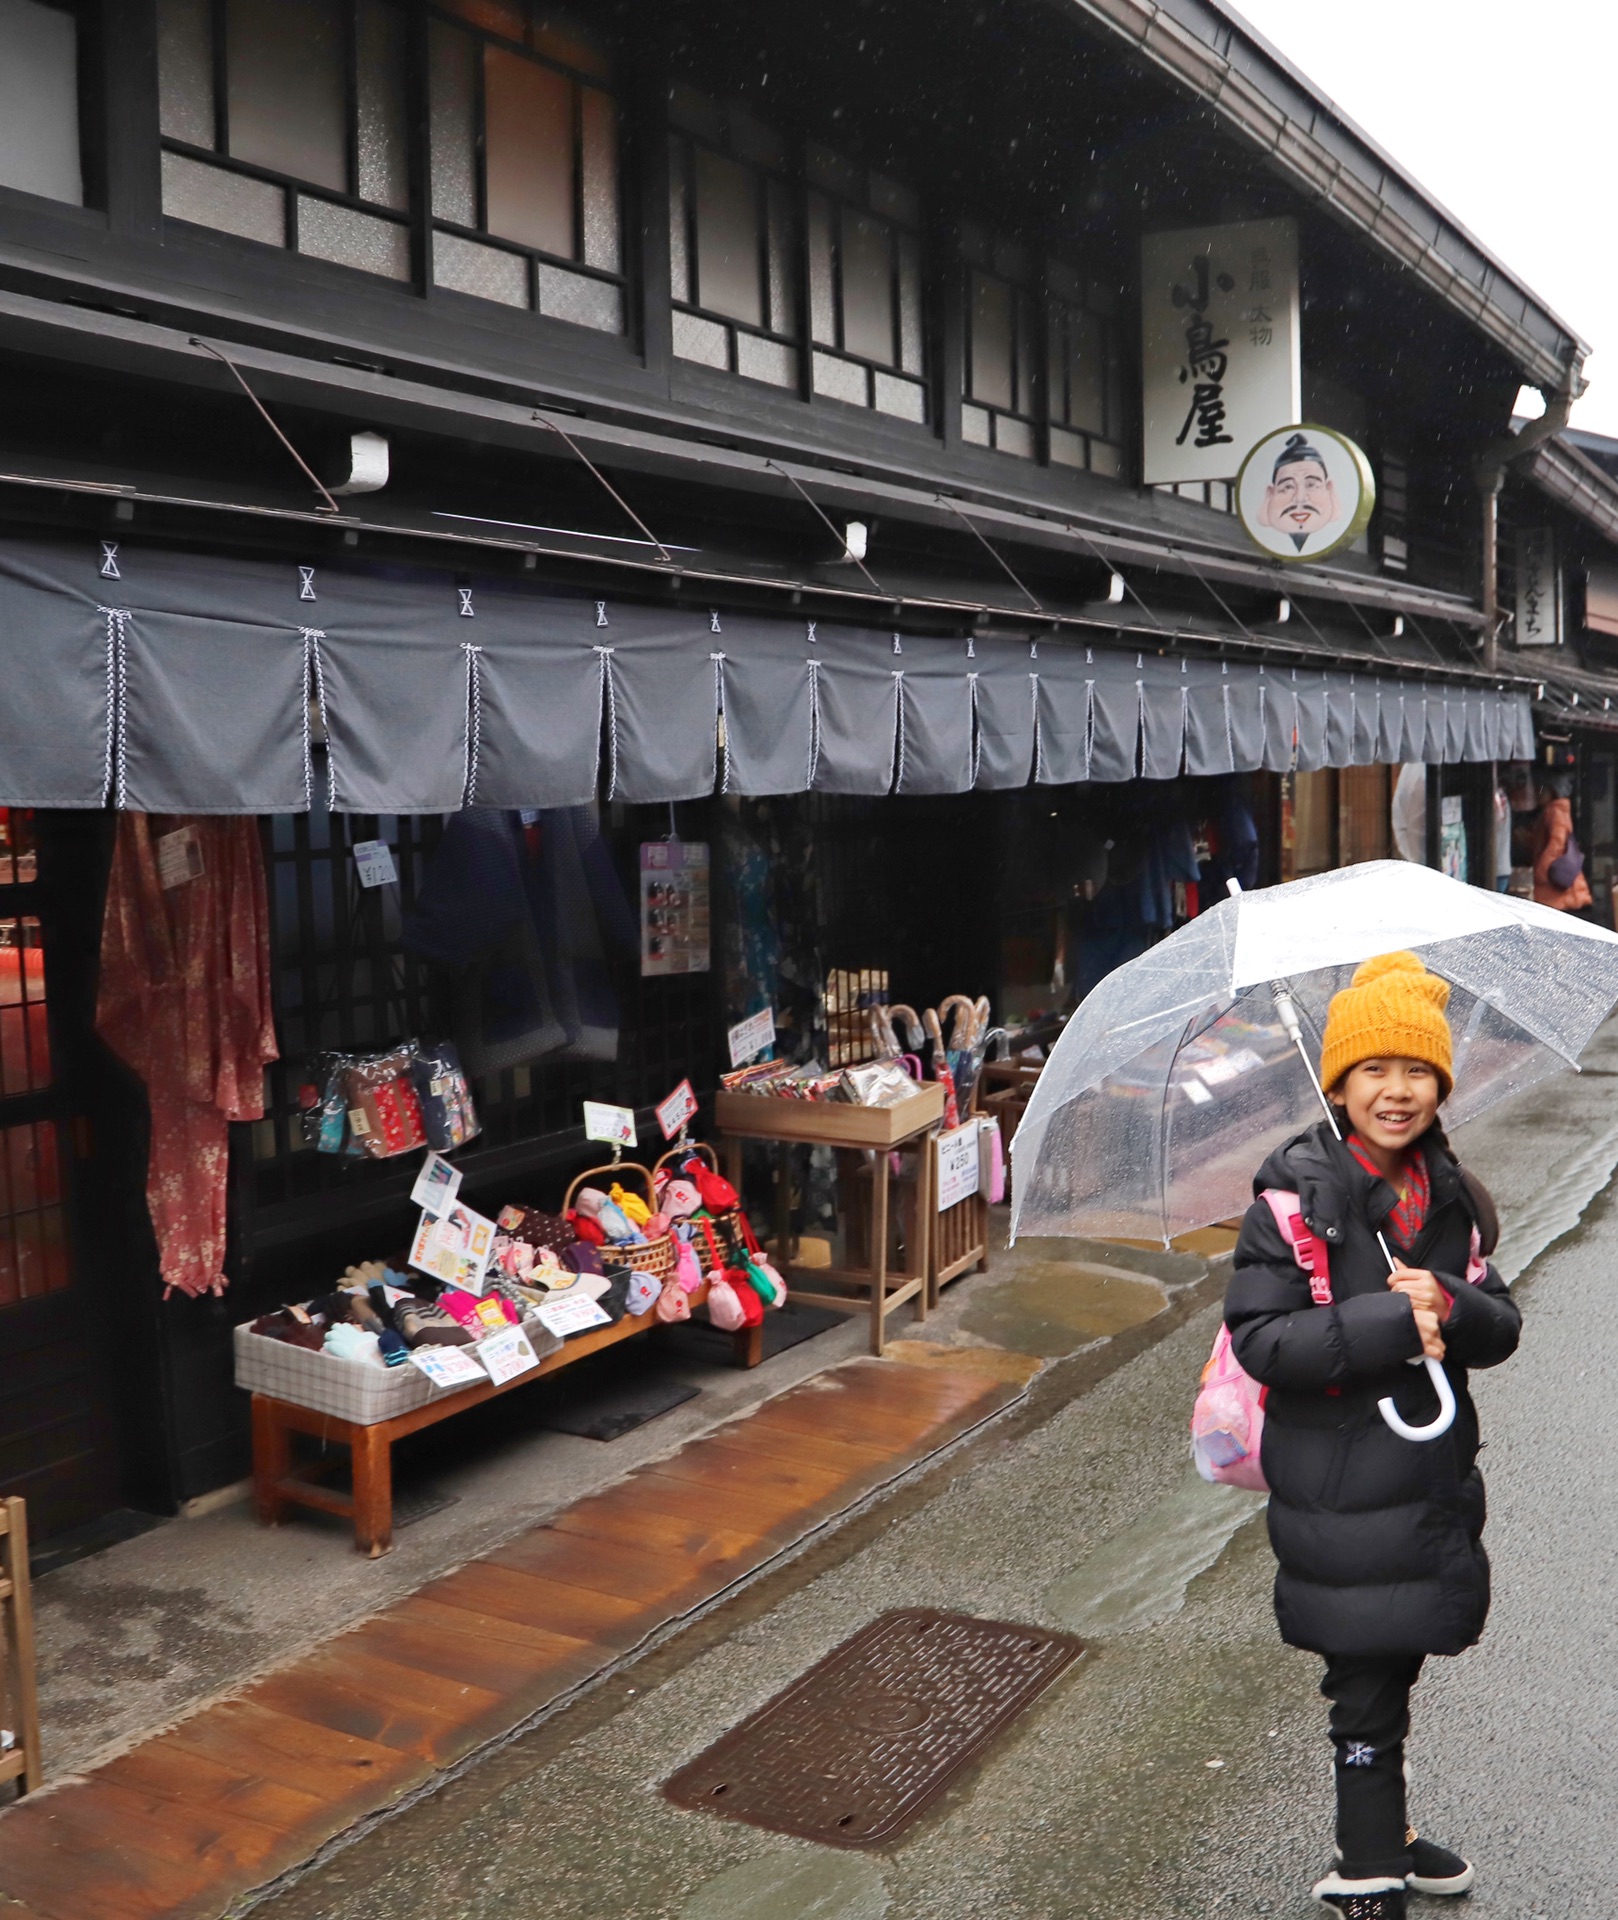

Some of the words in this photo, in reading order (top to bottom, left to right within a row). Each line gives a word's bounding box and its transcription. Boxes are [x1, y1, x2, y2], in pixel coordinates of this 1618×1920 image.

[1171, 253, 1235, 449] 小鳥屋
[1248, 303, 1273, 347] 太物
